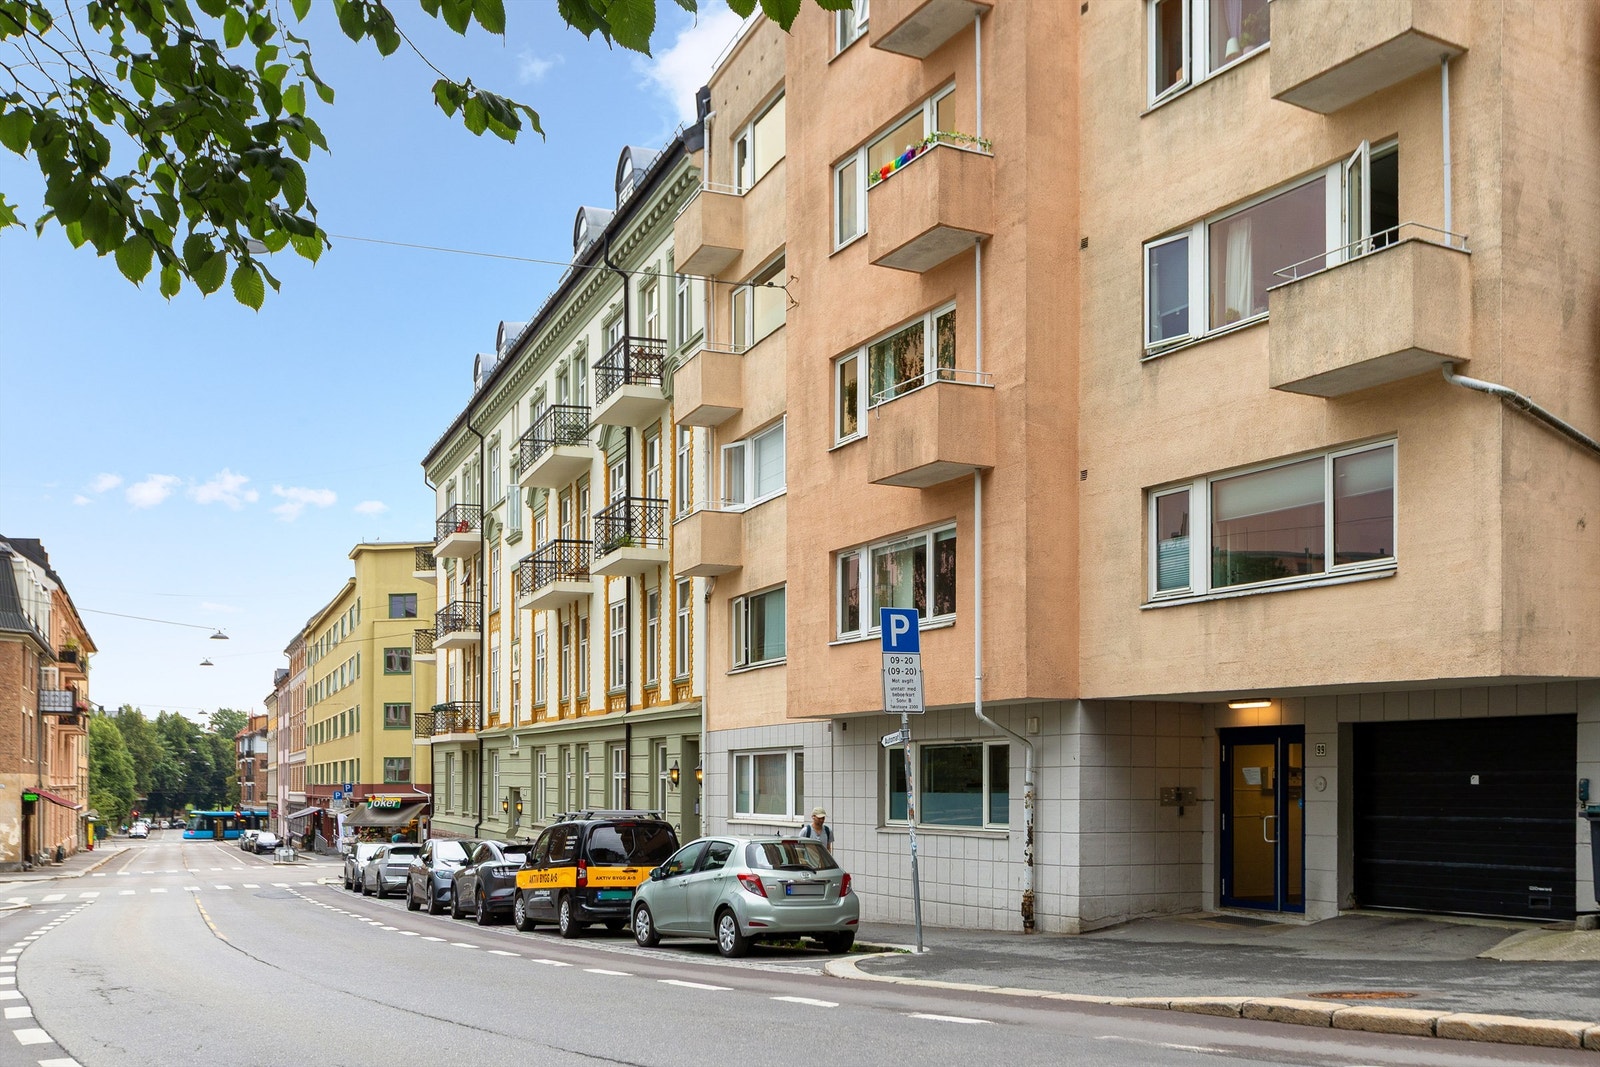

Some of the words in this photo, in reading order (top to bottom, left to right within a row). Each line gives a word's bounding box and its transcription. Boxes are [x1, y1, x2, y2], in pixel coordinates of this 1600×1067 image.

[890, 614, 910, 647] P
[890, 656, 913, 664] 09-20
[888, 667, 917, 676] (09-20)
[1317, 745, 1324, 754] 99
[529, 874, 539, 884] AKTIV
[539, 873, 550, 883] BYGG
